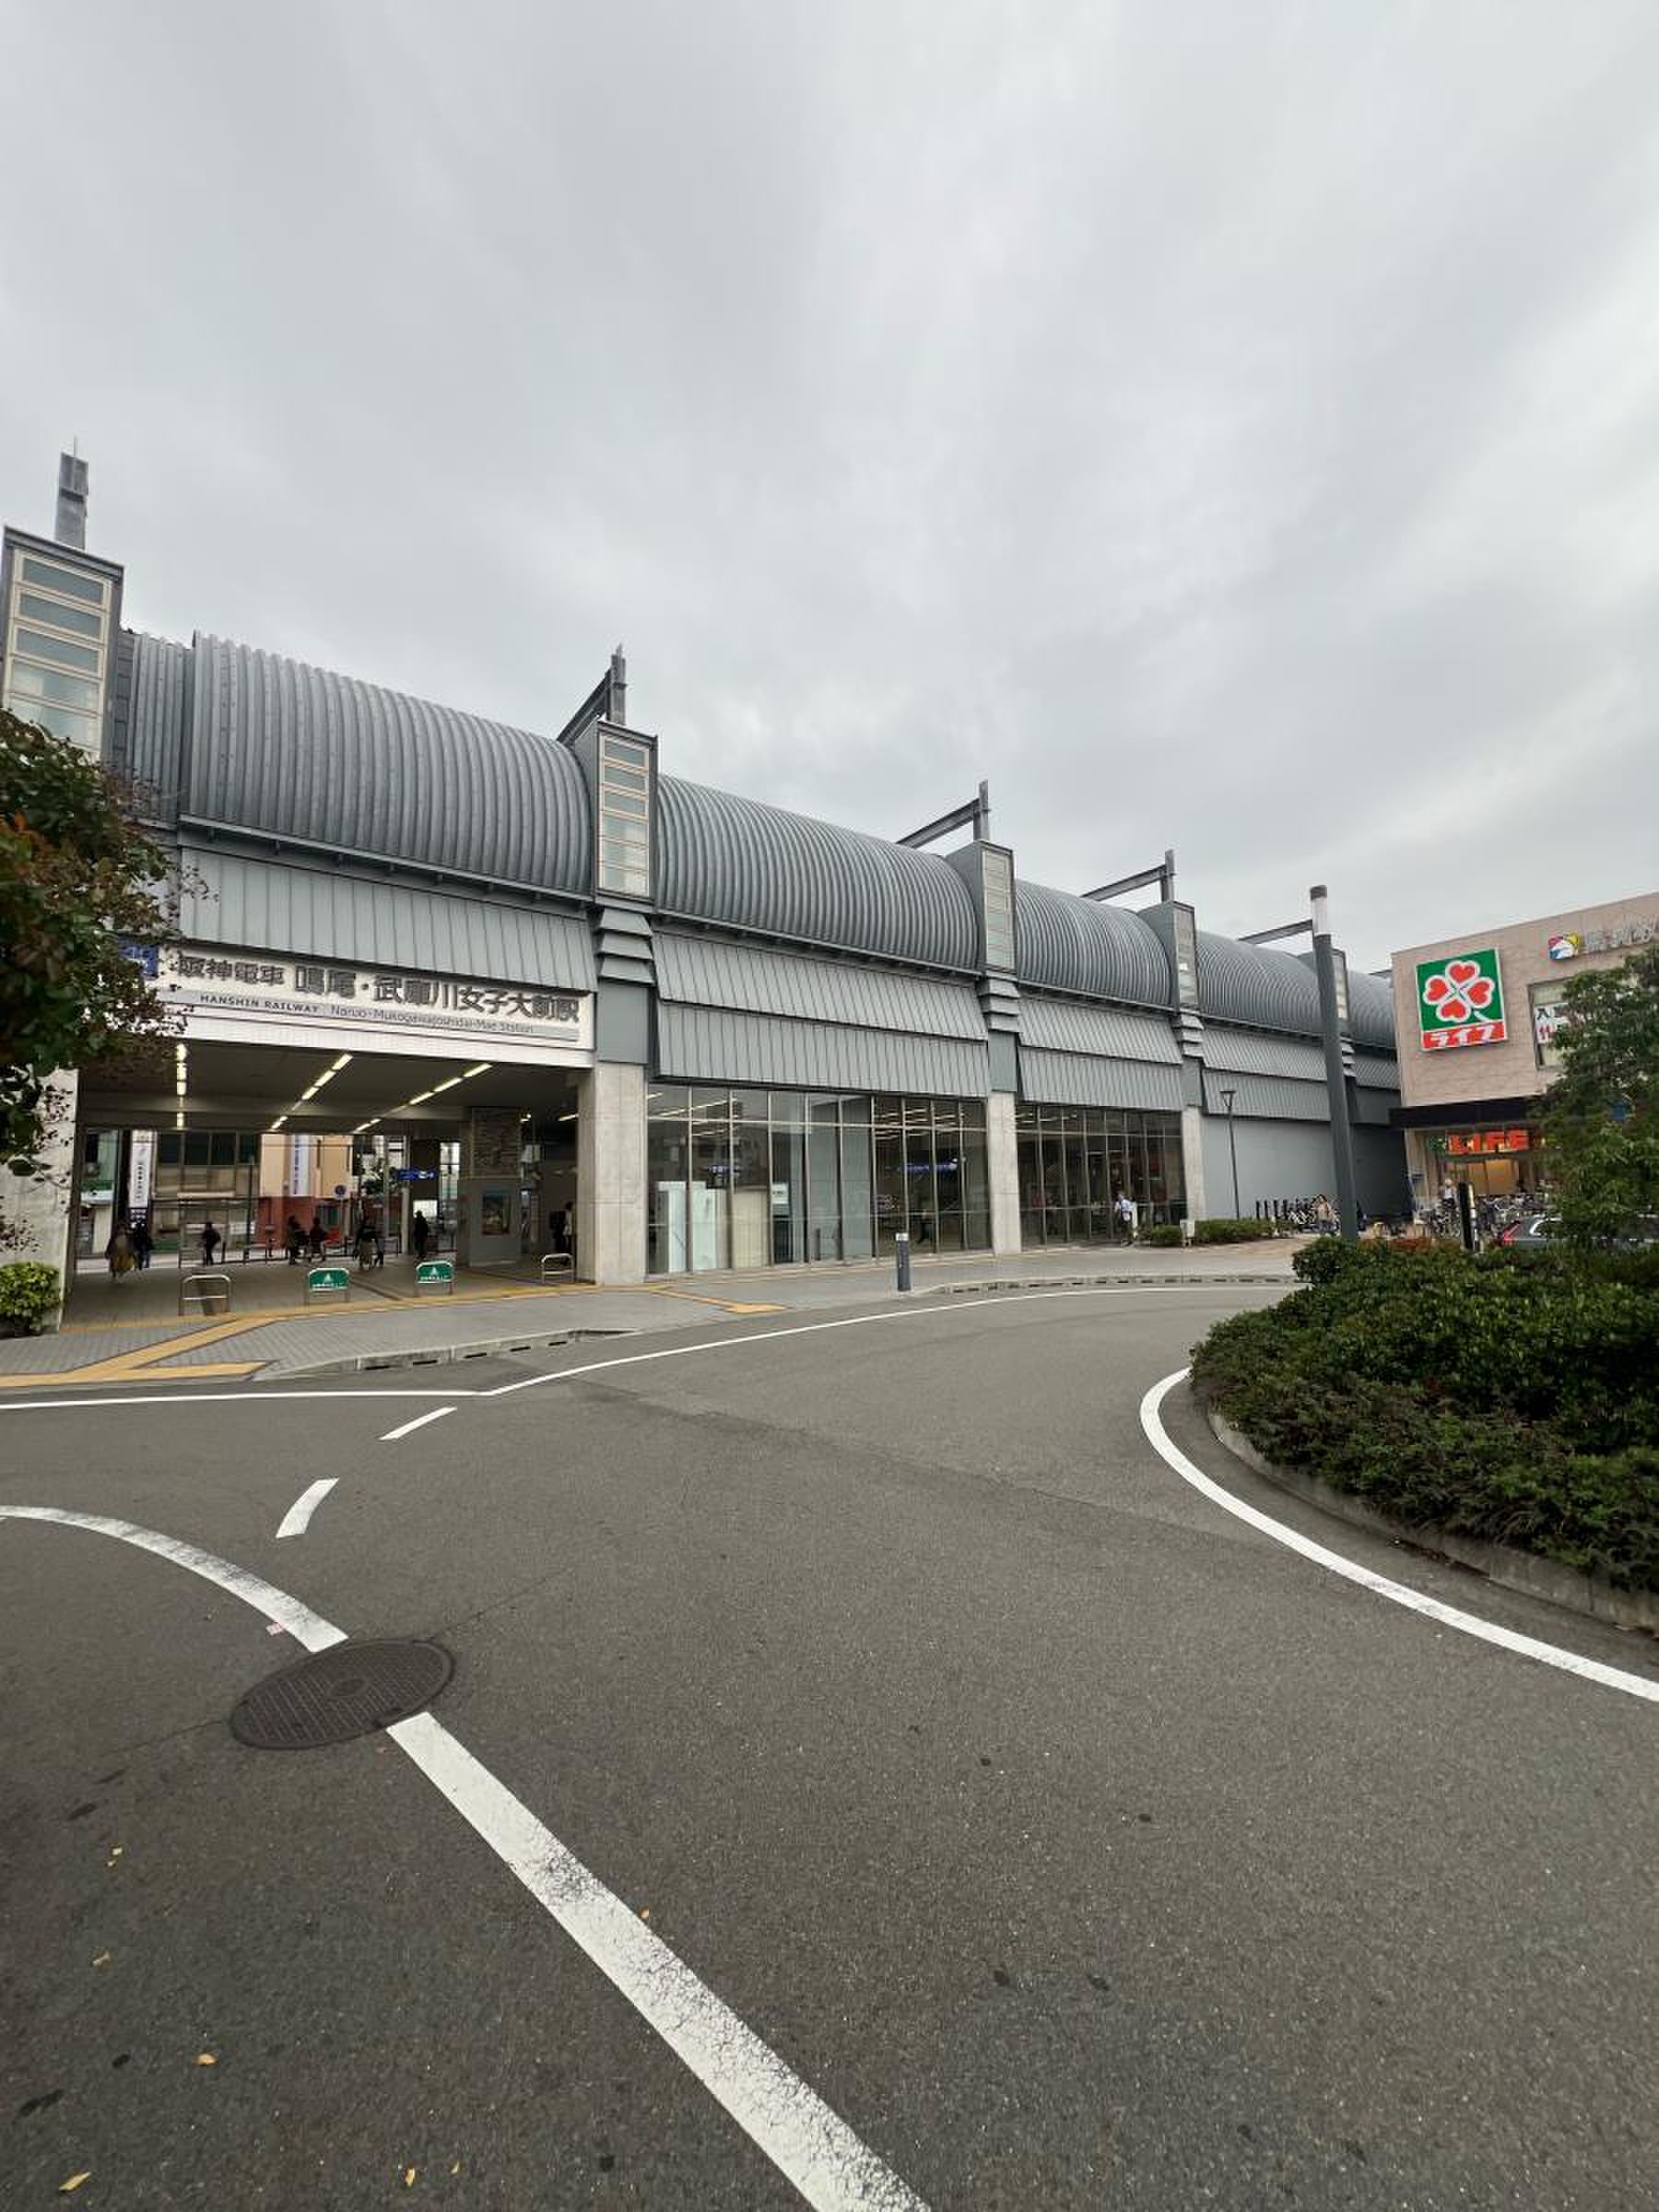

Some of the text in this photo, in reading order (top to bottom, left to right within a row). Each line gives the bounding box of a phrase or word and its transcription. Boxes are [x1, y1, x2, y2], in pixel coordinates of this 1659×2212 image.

[200, 994, 259, 1007] HANSHIN
[265, 1000, 320, 1014] RAILWAY
[1430, 1023, 1495, 1049] ライフ
[1448, 1129, 1529, 1156] LIFE
